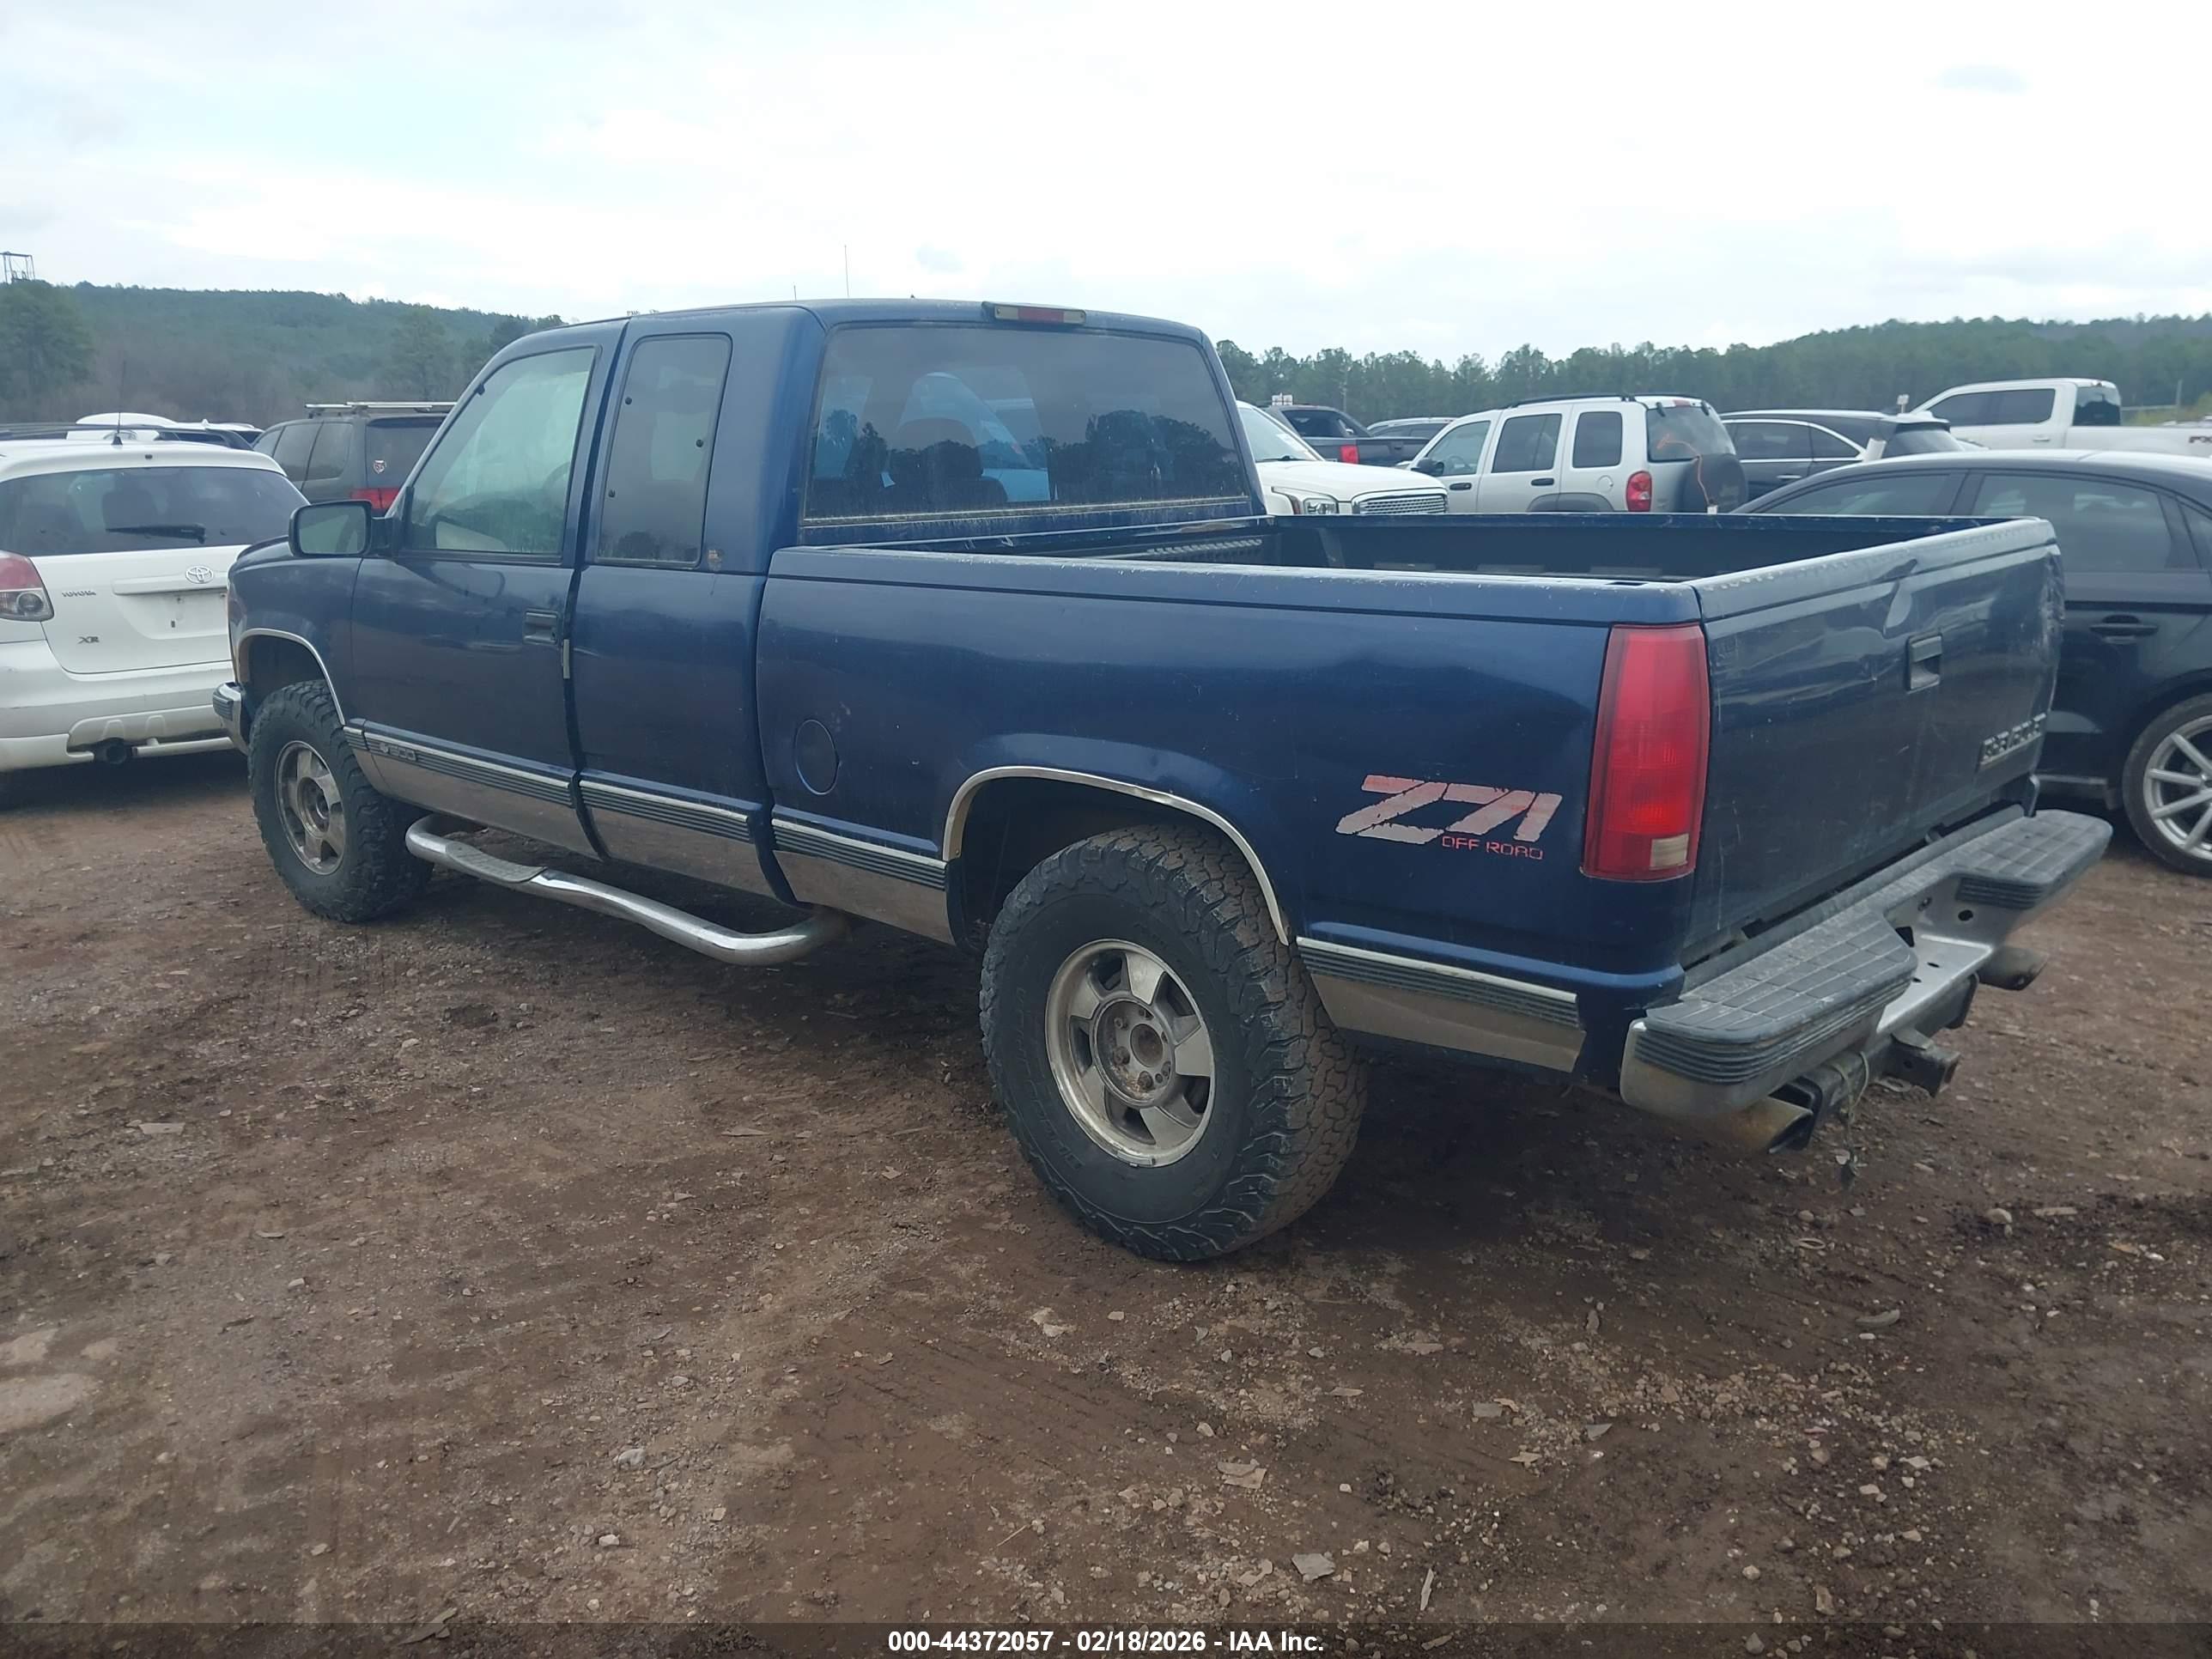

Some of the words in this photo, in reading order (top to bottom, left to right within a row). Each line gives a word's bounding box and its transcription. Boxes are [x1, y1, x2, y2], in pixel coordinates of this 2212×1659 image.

[1334, 774, 1563, 845] Z71
[1442, 836, 1480, 850] OFF
[1486, 842, 1544, 860] ROAD
